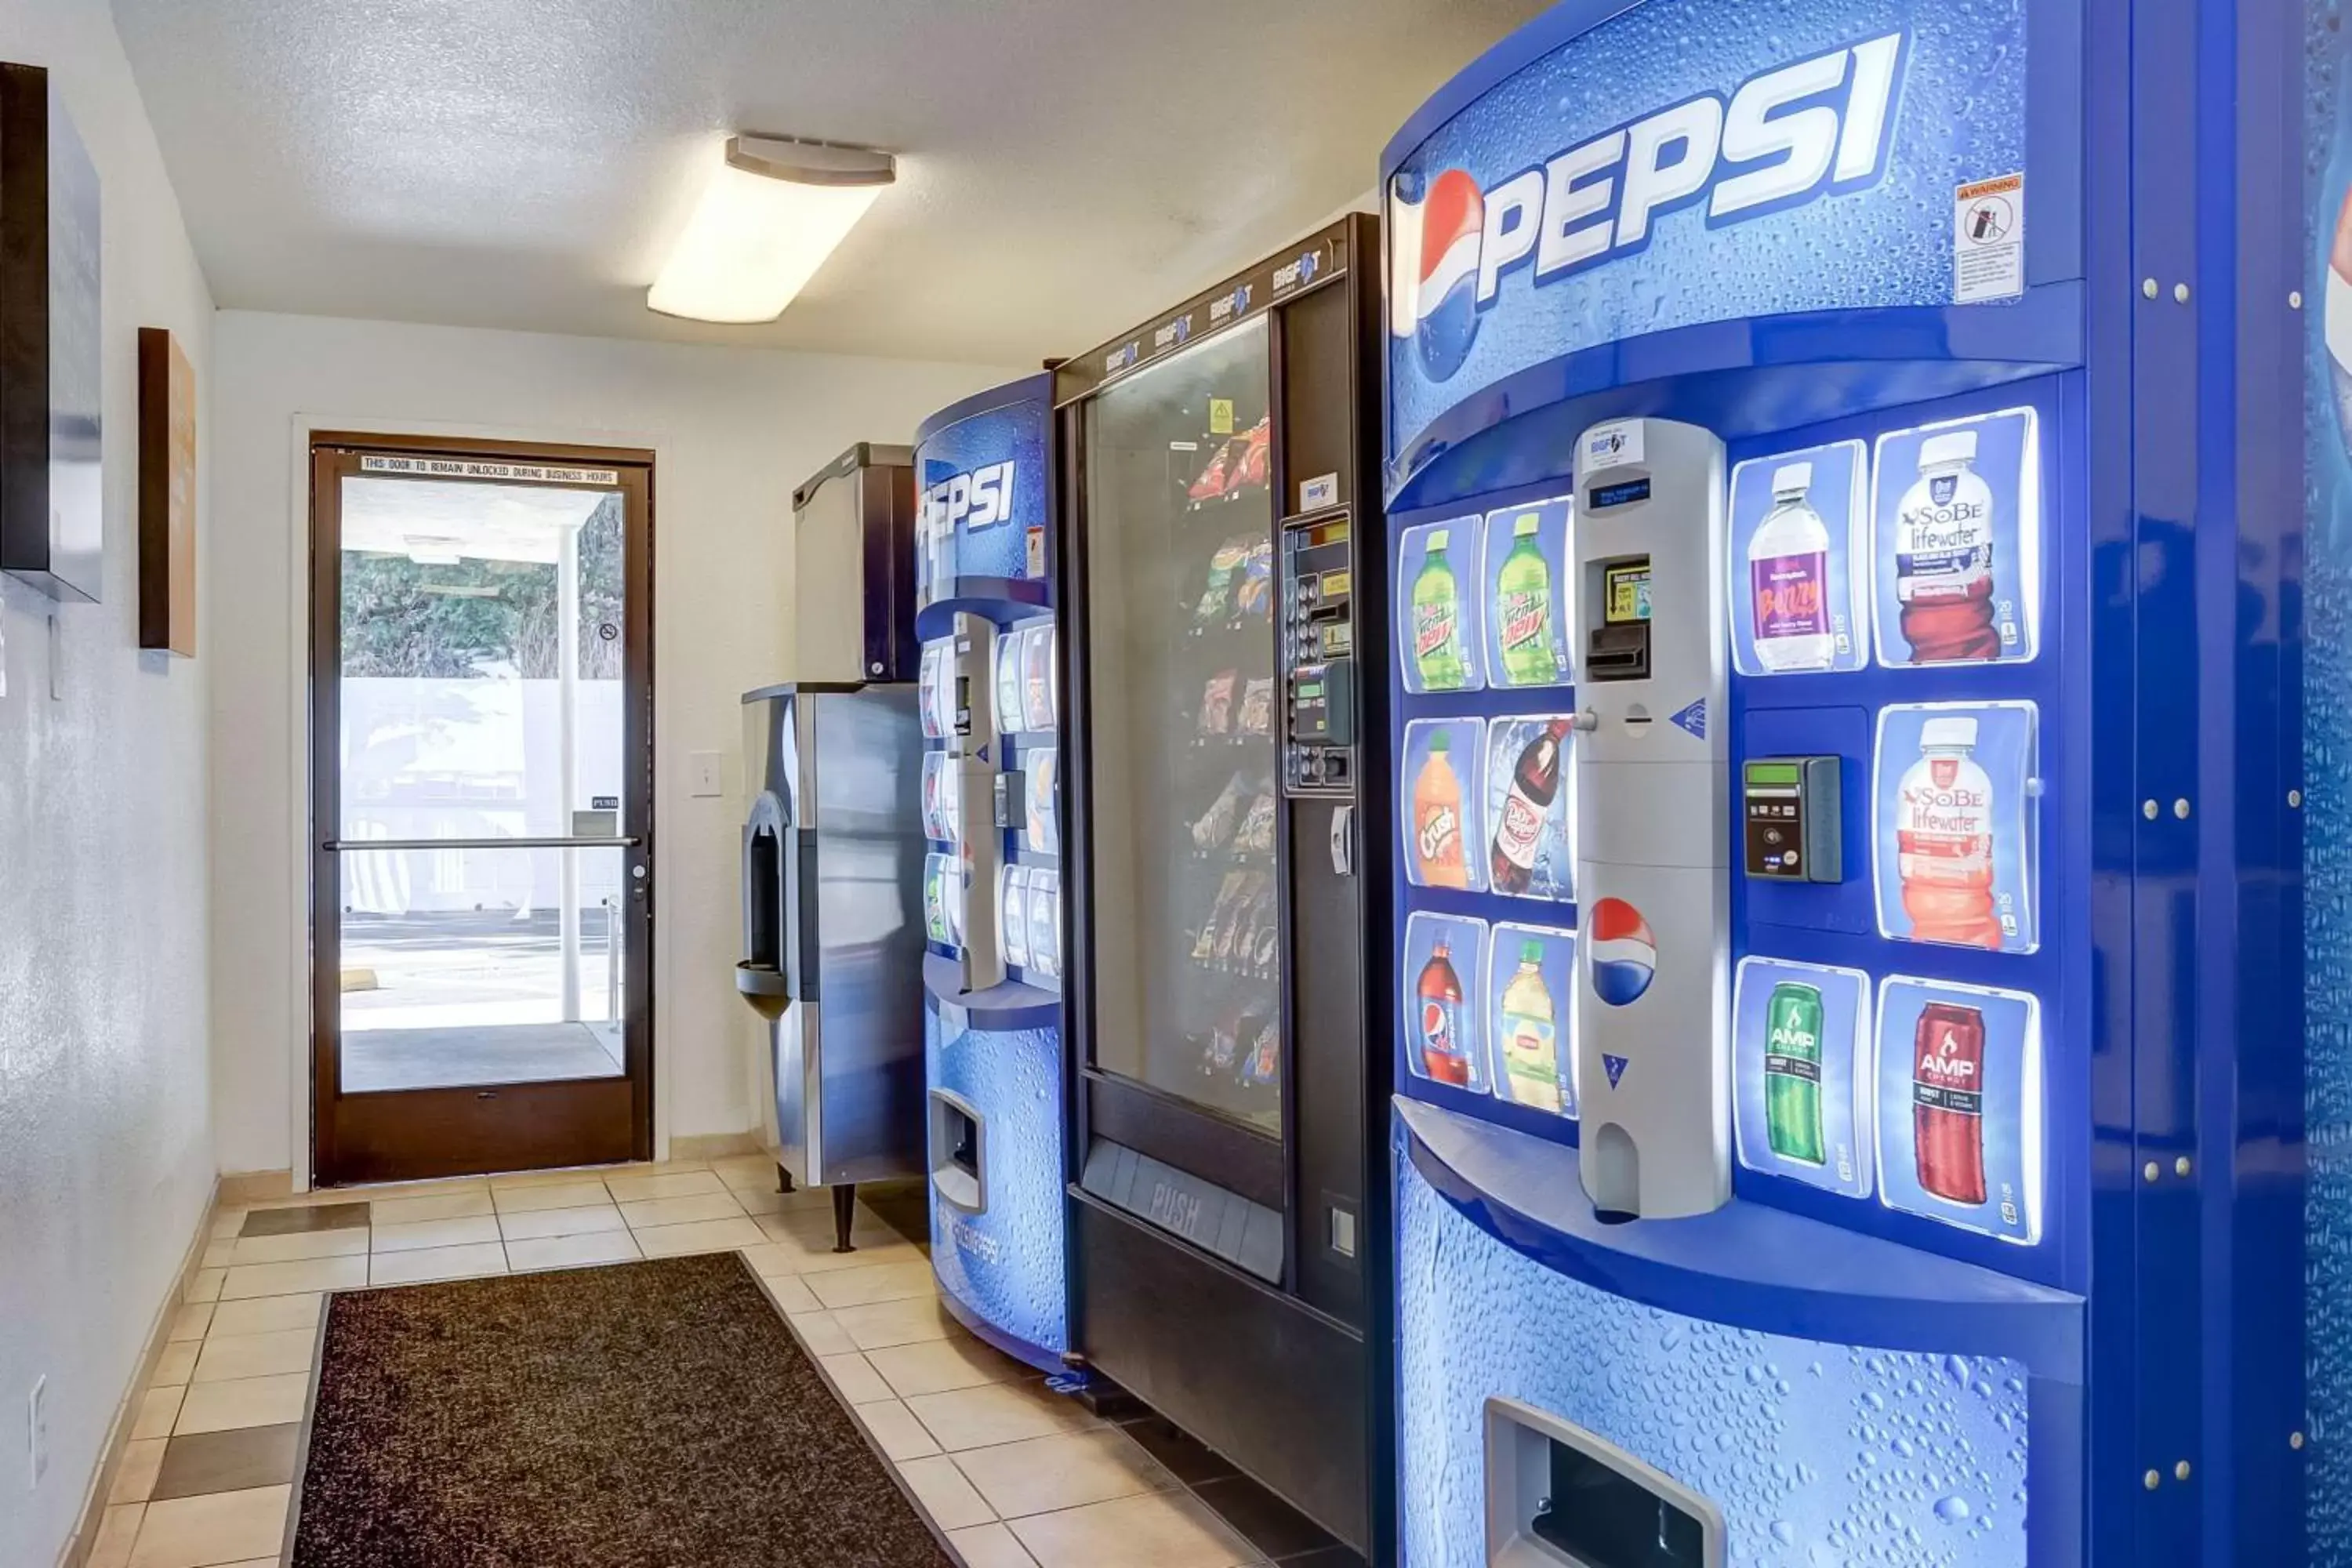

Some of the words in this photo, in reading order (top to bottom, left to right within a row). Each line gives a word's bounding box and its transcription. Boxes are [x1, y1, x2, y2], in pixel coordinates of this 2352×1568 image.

[1476, 33, 1901, 303] PEPSI
[1970, 178, 2019, 195] WARNING
[365, 457, 383, 468] THIS
[389, 459, 409, 470] DOOR
[416, 460, 426, 471] TO
[430, 462, 463, 473] REMAIN
[466, 463, 509, 476] UNLOCKED
[514, 466, 542, 478] DURING
[546, 469, 583, 481] BUSINESS
[587, 471, 613, 482] HOURS
[1911, 523, 1976, 550] lifewater
[1913, 807, 1979, 831] lifewater
[1420, 806, 1456, 859] Crush
[1771, 1028, 1815, 1047] AMP
[1919, 1054, 1974, 1077] AMP
[1149, 1182, 1202, 1236] PUSH
